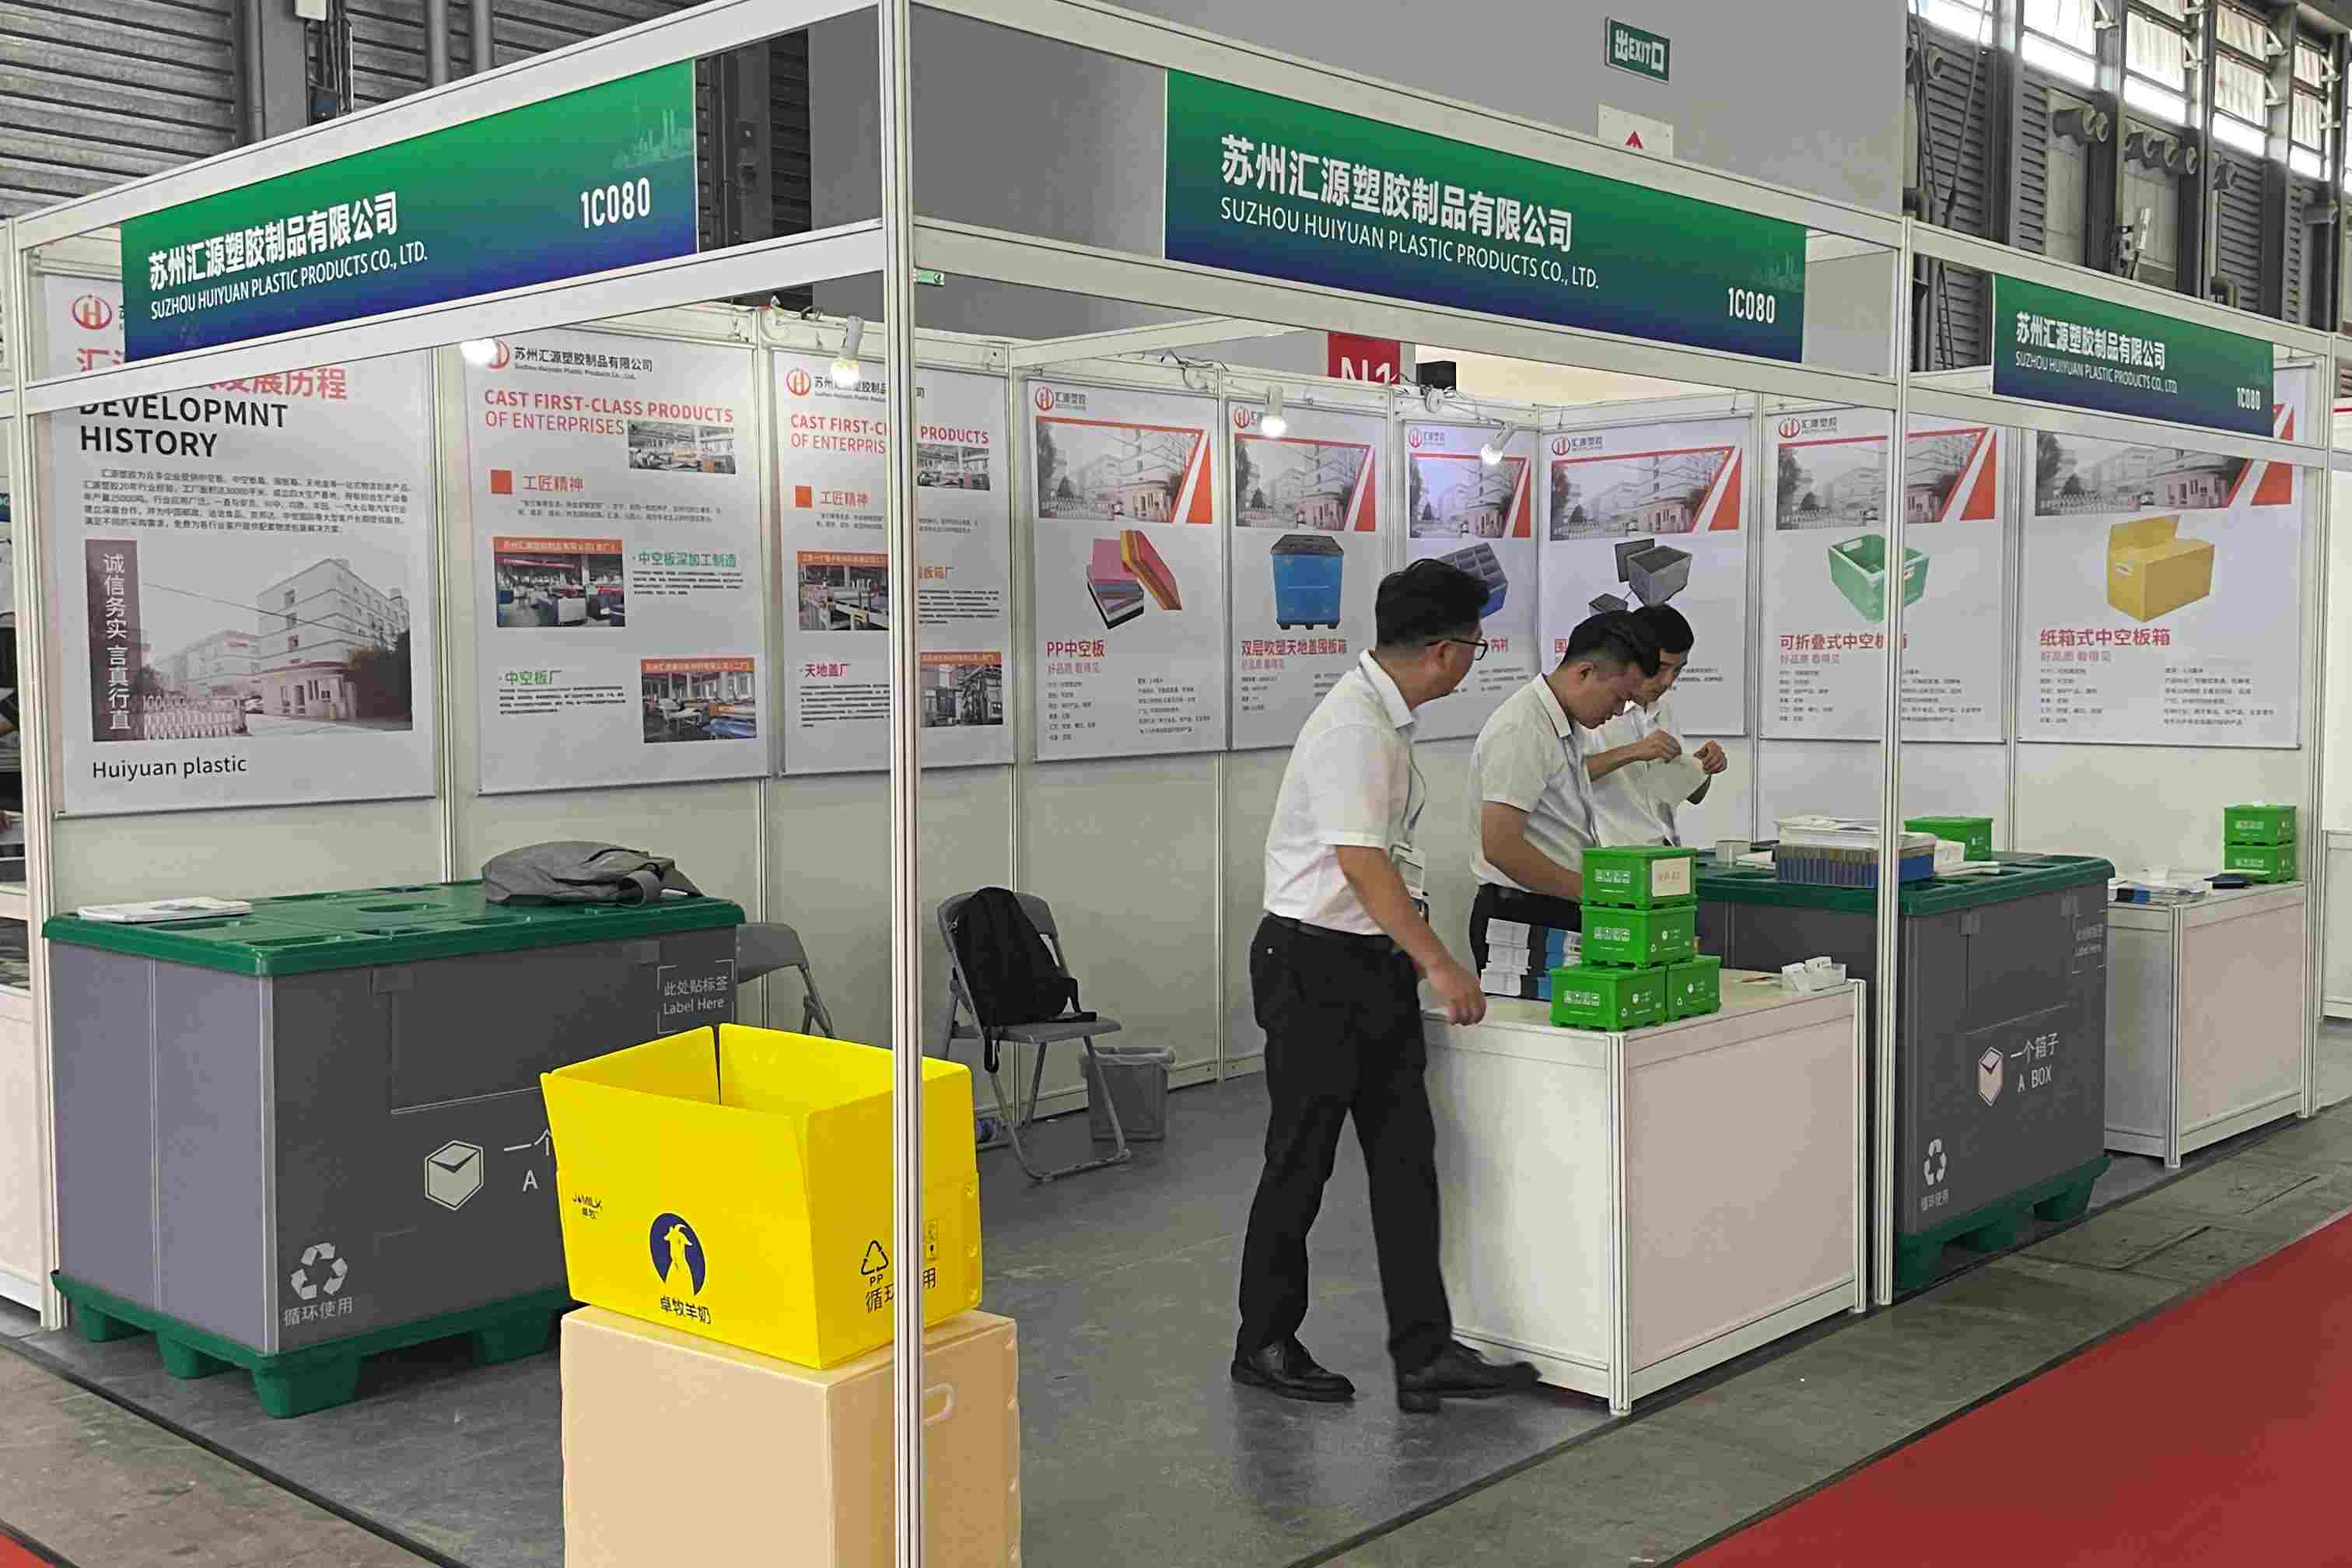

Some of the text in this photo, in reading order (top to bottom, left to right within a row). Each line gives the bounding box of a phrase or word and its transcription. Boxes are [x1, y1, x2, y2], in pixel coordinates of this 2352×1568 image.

[581, 177, 650, 229] 1C080
[1221, 135, 1572, 252] 苏州汇源塑胶制品有限公司
[149, 191, 397, 291] 苏州汇源塑胶制品有限公司
[1221, 197, 1299, 233] SUZHOU
[1304, 214, 1384, 250] HUIYUAN
[1388, 230, 1454, 262] PLASTIC
[1457, 243, 1538, 278] PRODUCTS
[1571, 266, 1599, 289] LTD.
[151, 294, 196, 320] SUZHOU
[198, 281, 249, 310] HUIYUAN
[251, 269, 299, 296] PLASTIC
[301, 253, 368, 288] PRODUCTS
[400, 242, 428, 266] LTD.
[1728, 287, 1775, 324] 1C080
[2016, 311, 2165, 370] 苏州汇源塑胶制品有限公司
[514, 347, 653, 373] 苏州汇源塑胶制品有限公司
[2016, 351, 2048, 371] SUZHOU
[2049, 358, 2084, 377] HUIYUAN
[2085, 364, 2113, 383] PLASTIC
[2114, 369, 2151, 389] PRODUCTS
[485, 390, 733, 423] CAST FIRST-CLASS PRODUCTS
[2236, 387, 2261, 411] 1C080
[485, 411, 625, 436] OF ENTERPRISES
[790, 414, 827, 430] CAST
[920, 425, 989, 445] PRODUCTS
[80, 425, 217, 457] HISTORY
[790, 433, 809, 448] OF
[523, 475, 583, 492] 工匠精神
[103, 553, 128, 639] 诚信务实
[1047, 639, 1105, 658] PP中空板
[2040, 628, 2170, 647] 纸箱式中空板箱
[504, 670, 562, 685] 中空板厂
[93, 755, 247, 781] Huiyuan plastic
[664, 975, 727, 996] 此处贴标签
[663, 998, 724, 1014] Label Here
[2011, 1033, 2060, 1063] 一个箱子
[2018, 1066, 2053, 1093] A BOX
[523, 1170, 538, 1192] A
[870, 1274, 884, 1286] PP
[283, 1297, 355, 1326] 循环使用
[660, 1295, 711, 1324] 卓牧羊奶
